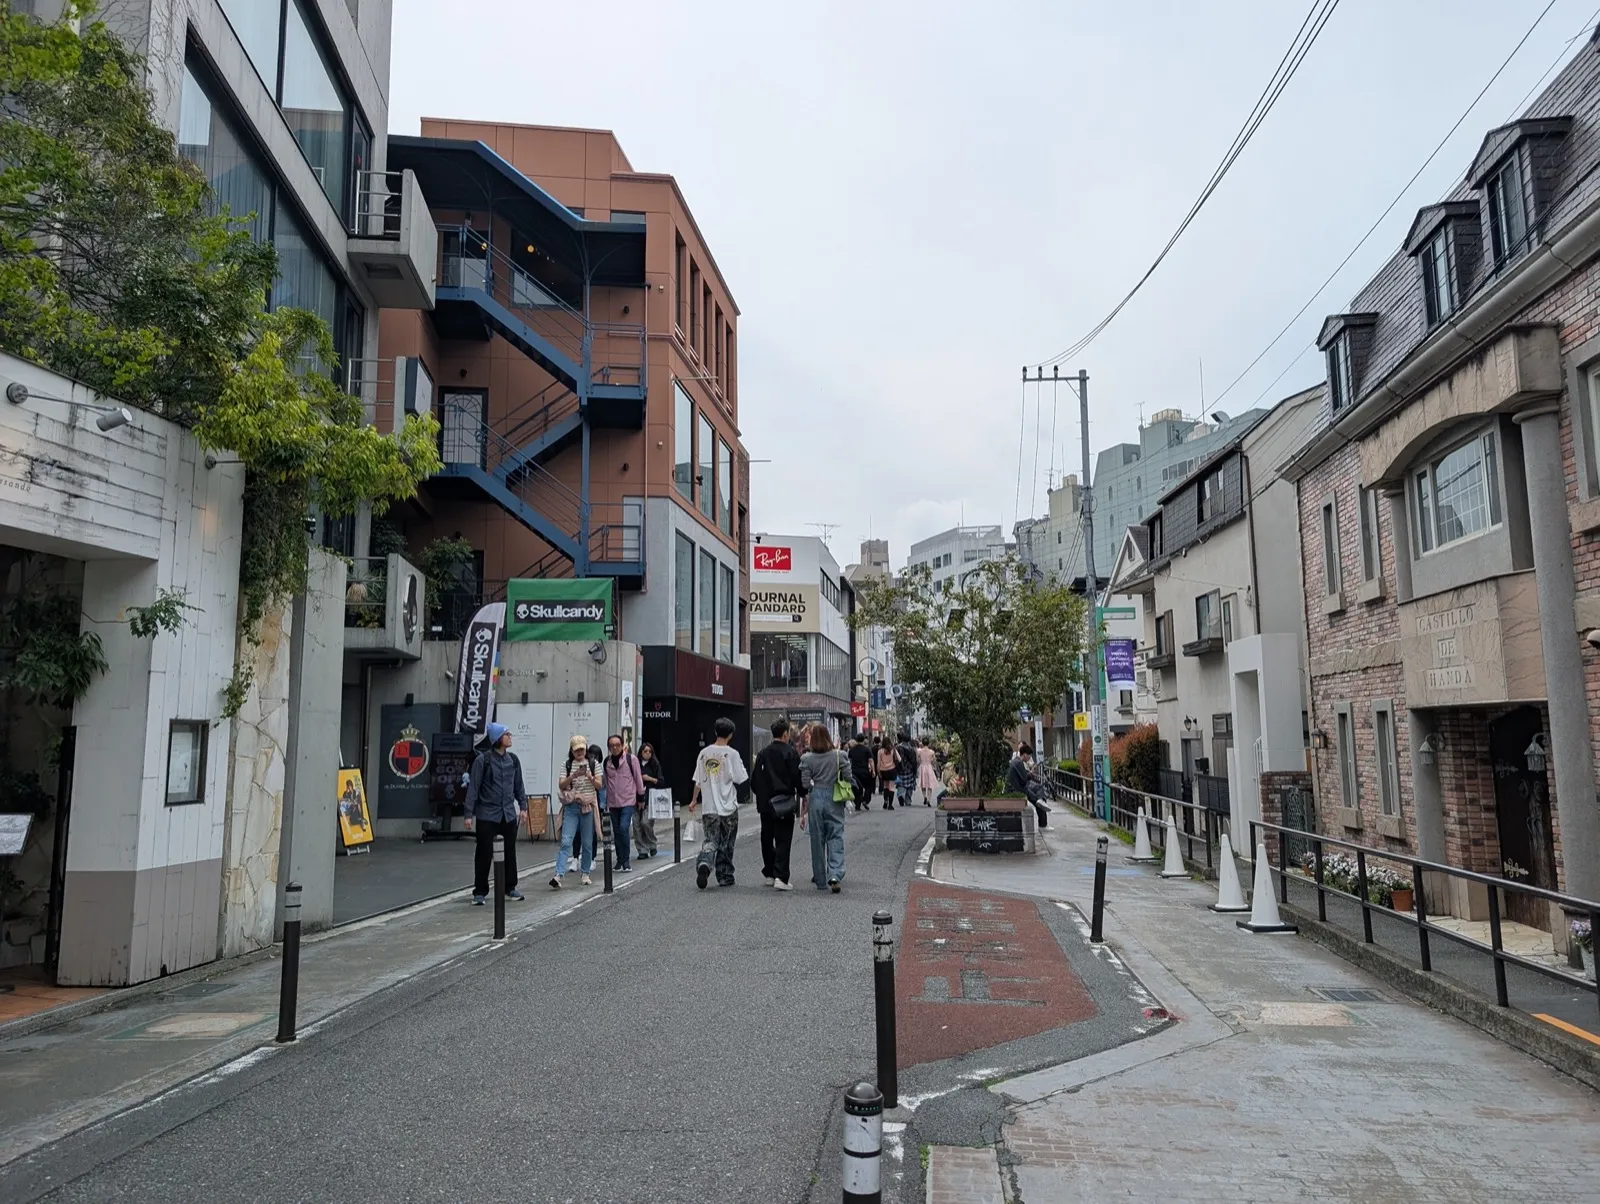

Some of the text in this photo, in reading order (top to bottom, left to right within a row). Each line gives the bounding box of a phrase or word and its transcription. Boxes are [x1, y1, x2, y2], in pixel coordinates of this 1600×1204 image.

[756, 549, 789, 567] Ray-Ban
[529, 604, 604, 621] Skullcandy
[1419, 607, 1474, 631] CASTILLO
[1440, 640, 1455, 657] DE
[463, 642, 490, 730] Skullcandy
[1430, 670, 1472, 686] HANDA
[711, 683, 724, 696] TUDOR
[644, 711, 671, 719] TUDOR
